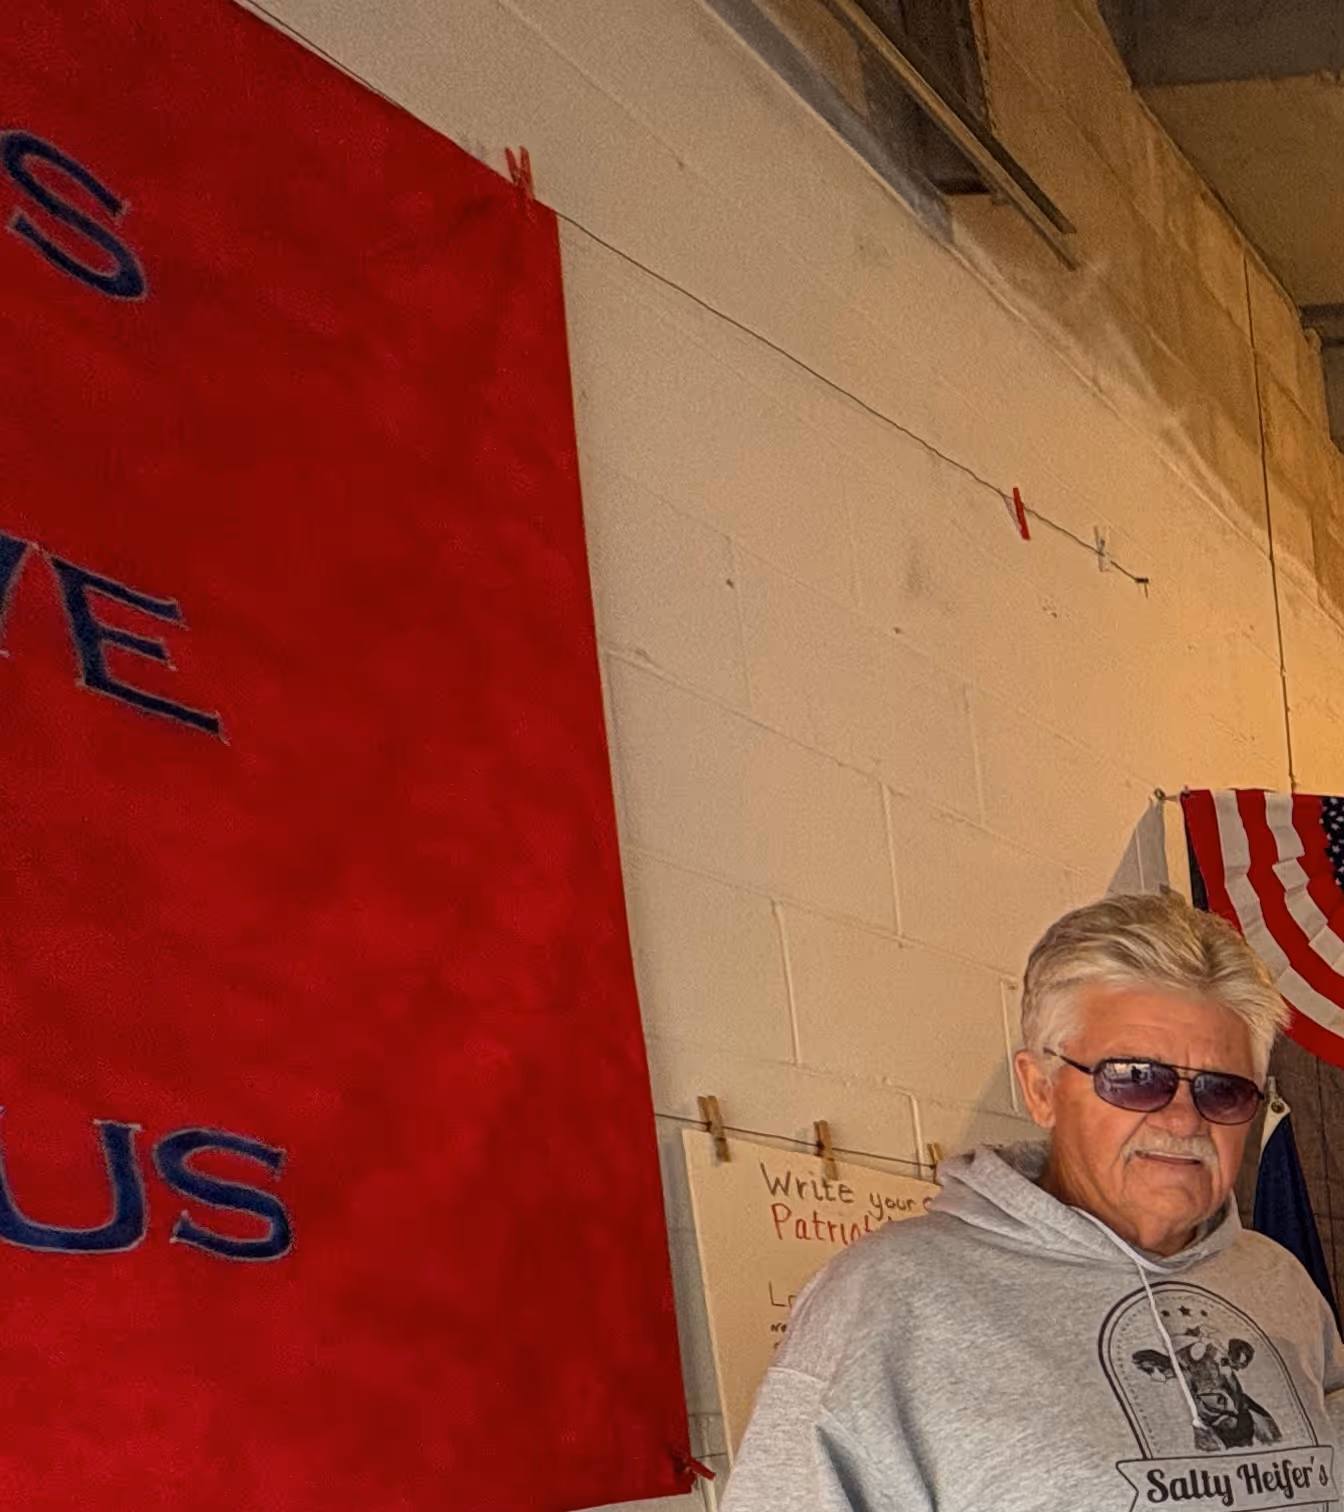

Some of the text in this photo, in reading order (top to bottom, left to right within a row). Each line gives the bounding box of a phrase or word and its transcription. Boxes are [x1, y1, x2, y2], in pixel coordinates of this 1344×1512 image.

[760, 1162, 854, 1204] Write
[868, 1192, 914, 1221] your
[1147, 1455, 1329, 1507] Salty Heifer's
